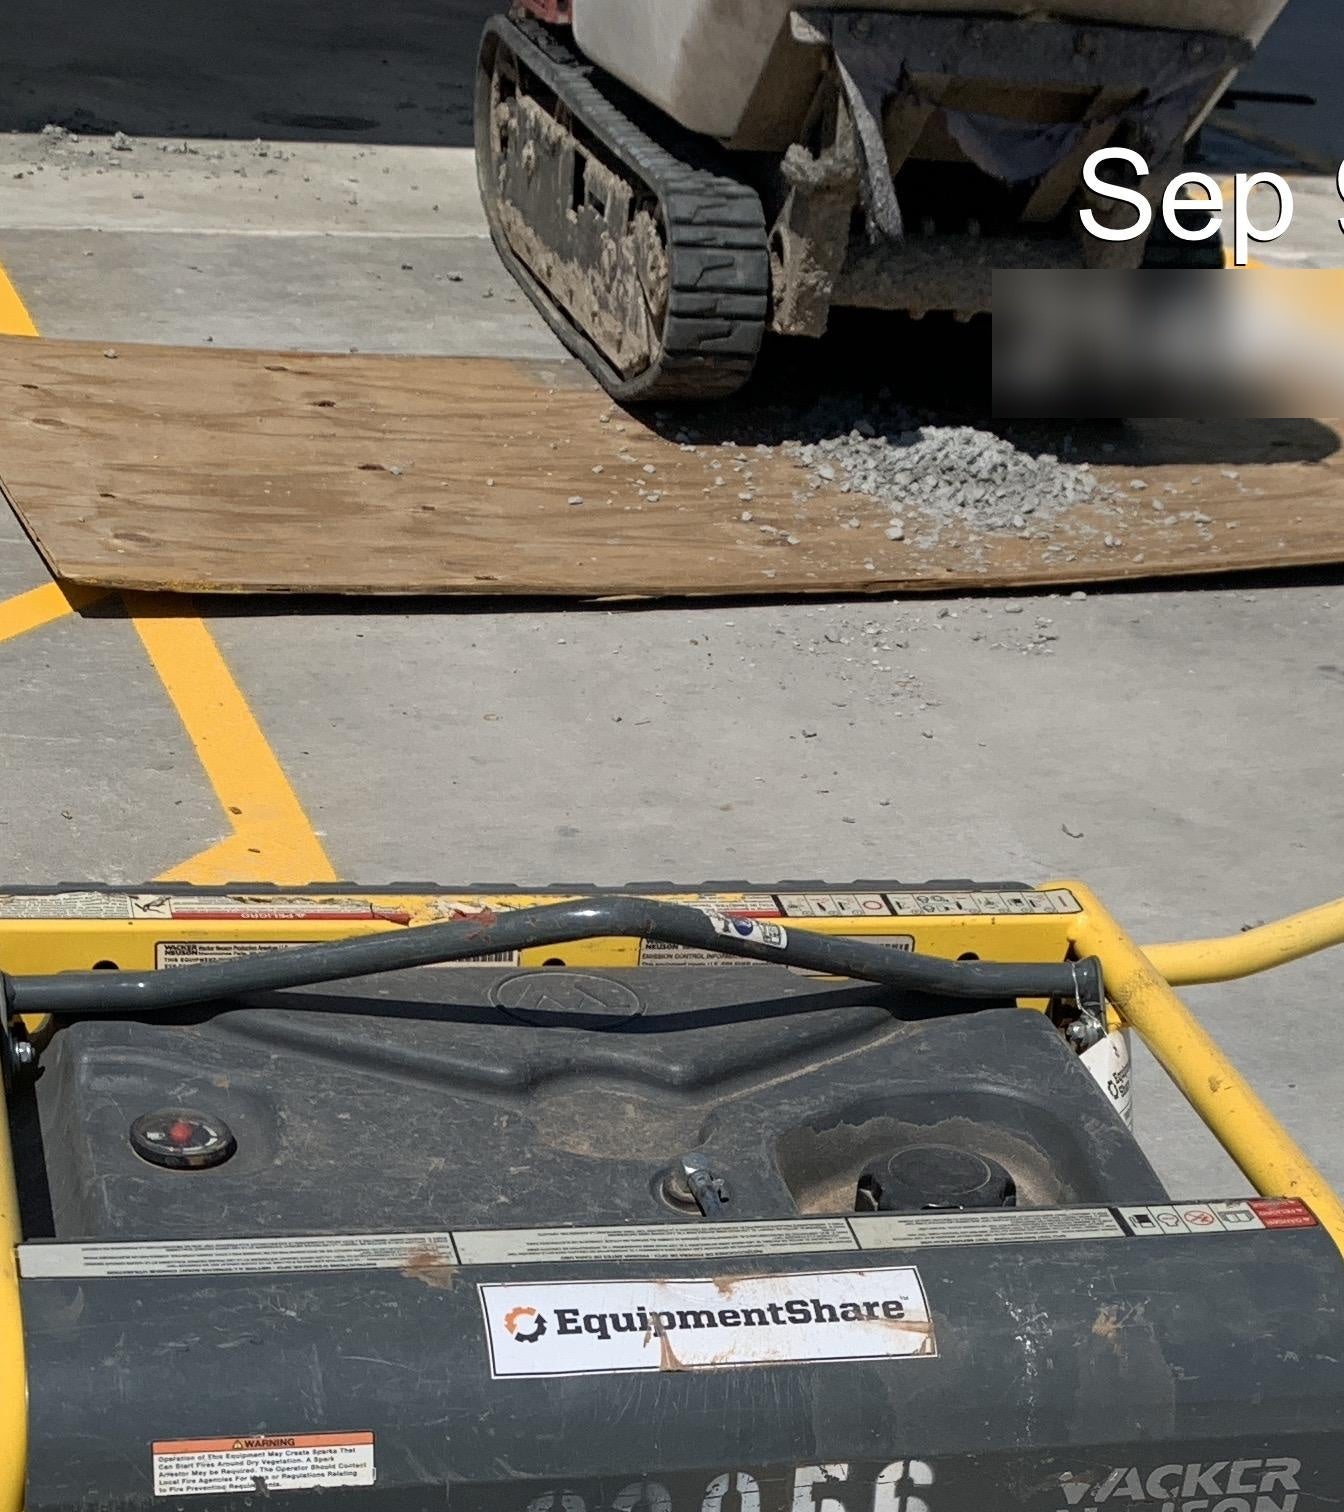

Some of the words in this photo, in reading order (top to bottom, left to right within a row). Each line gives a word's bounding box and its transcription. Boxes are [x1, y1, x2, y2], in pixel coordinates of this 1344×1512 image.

[554, 1298, 905, 1340] EquipmentShare
[245, 1437, 295, 1449] WARNING
[225, 1451, 266, 1460] Equipment
[275, 1464, 309, 1473] Operator
